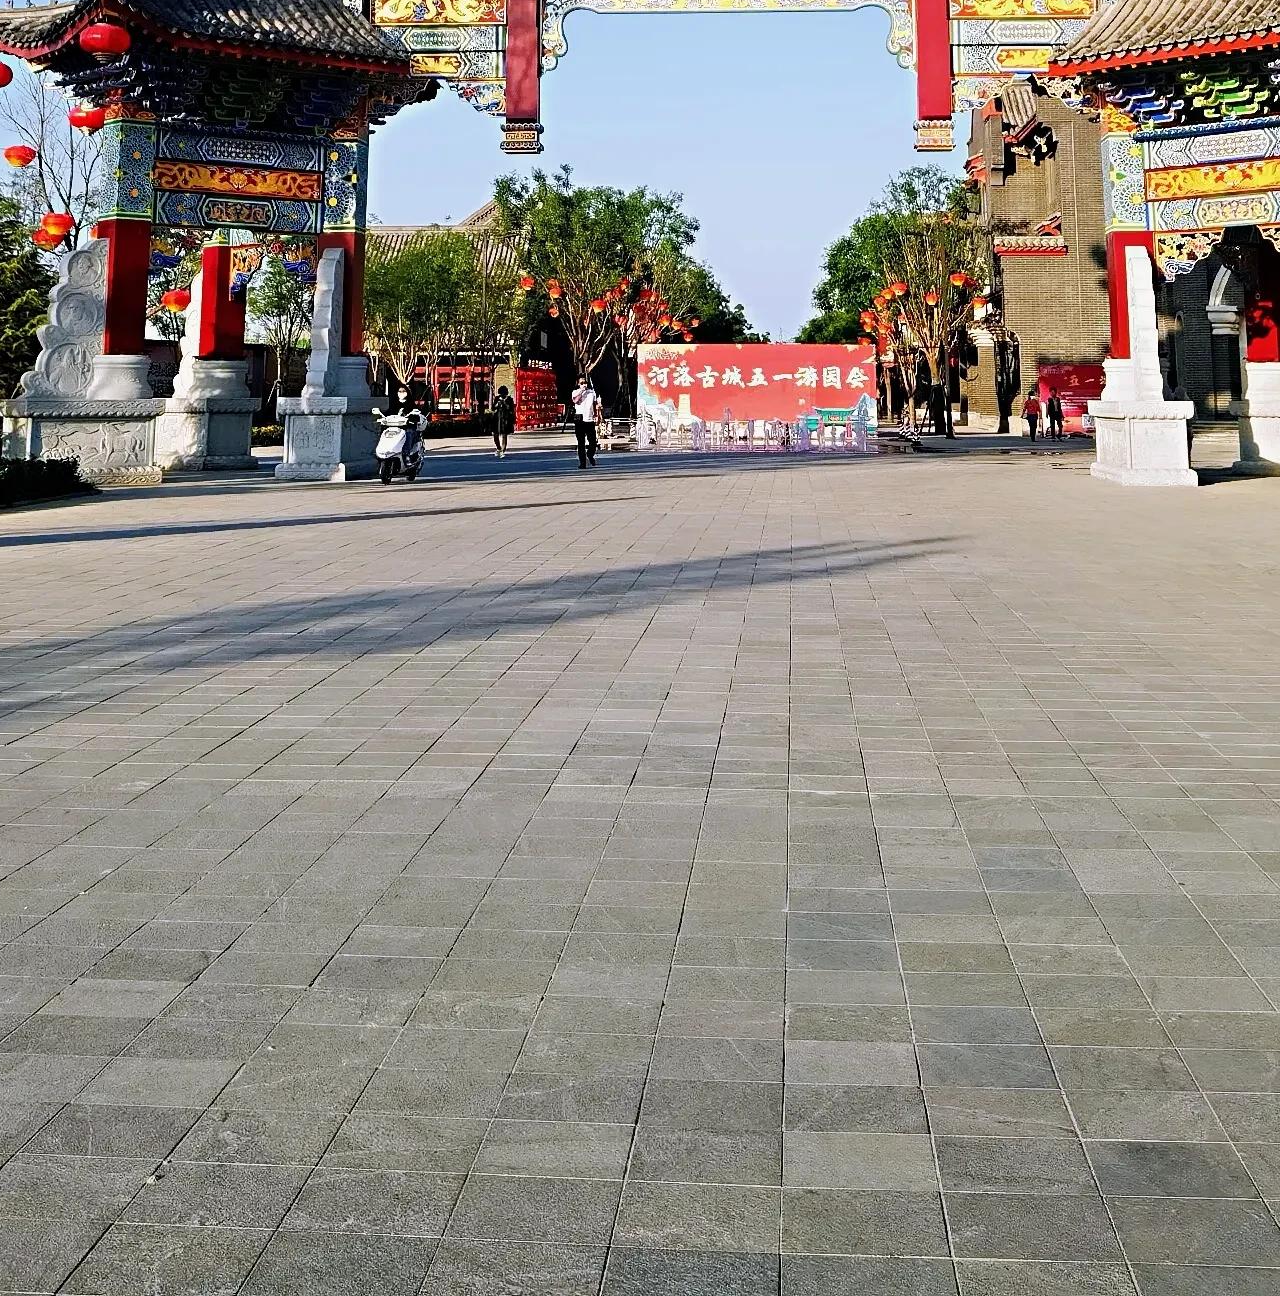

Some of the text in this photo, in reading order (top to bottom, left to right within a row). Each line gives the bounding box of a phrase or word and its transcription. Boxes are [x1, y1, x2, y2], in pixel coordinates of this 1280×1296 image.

[648, 365, 869, 389] 河洛古城五一游园会
